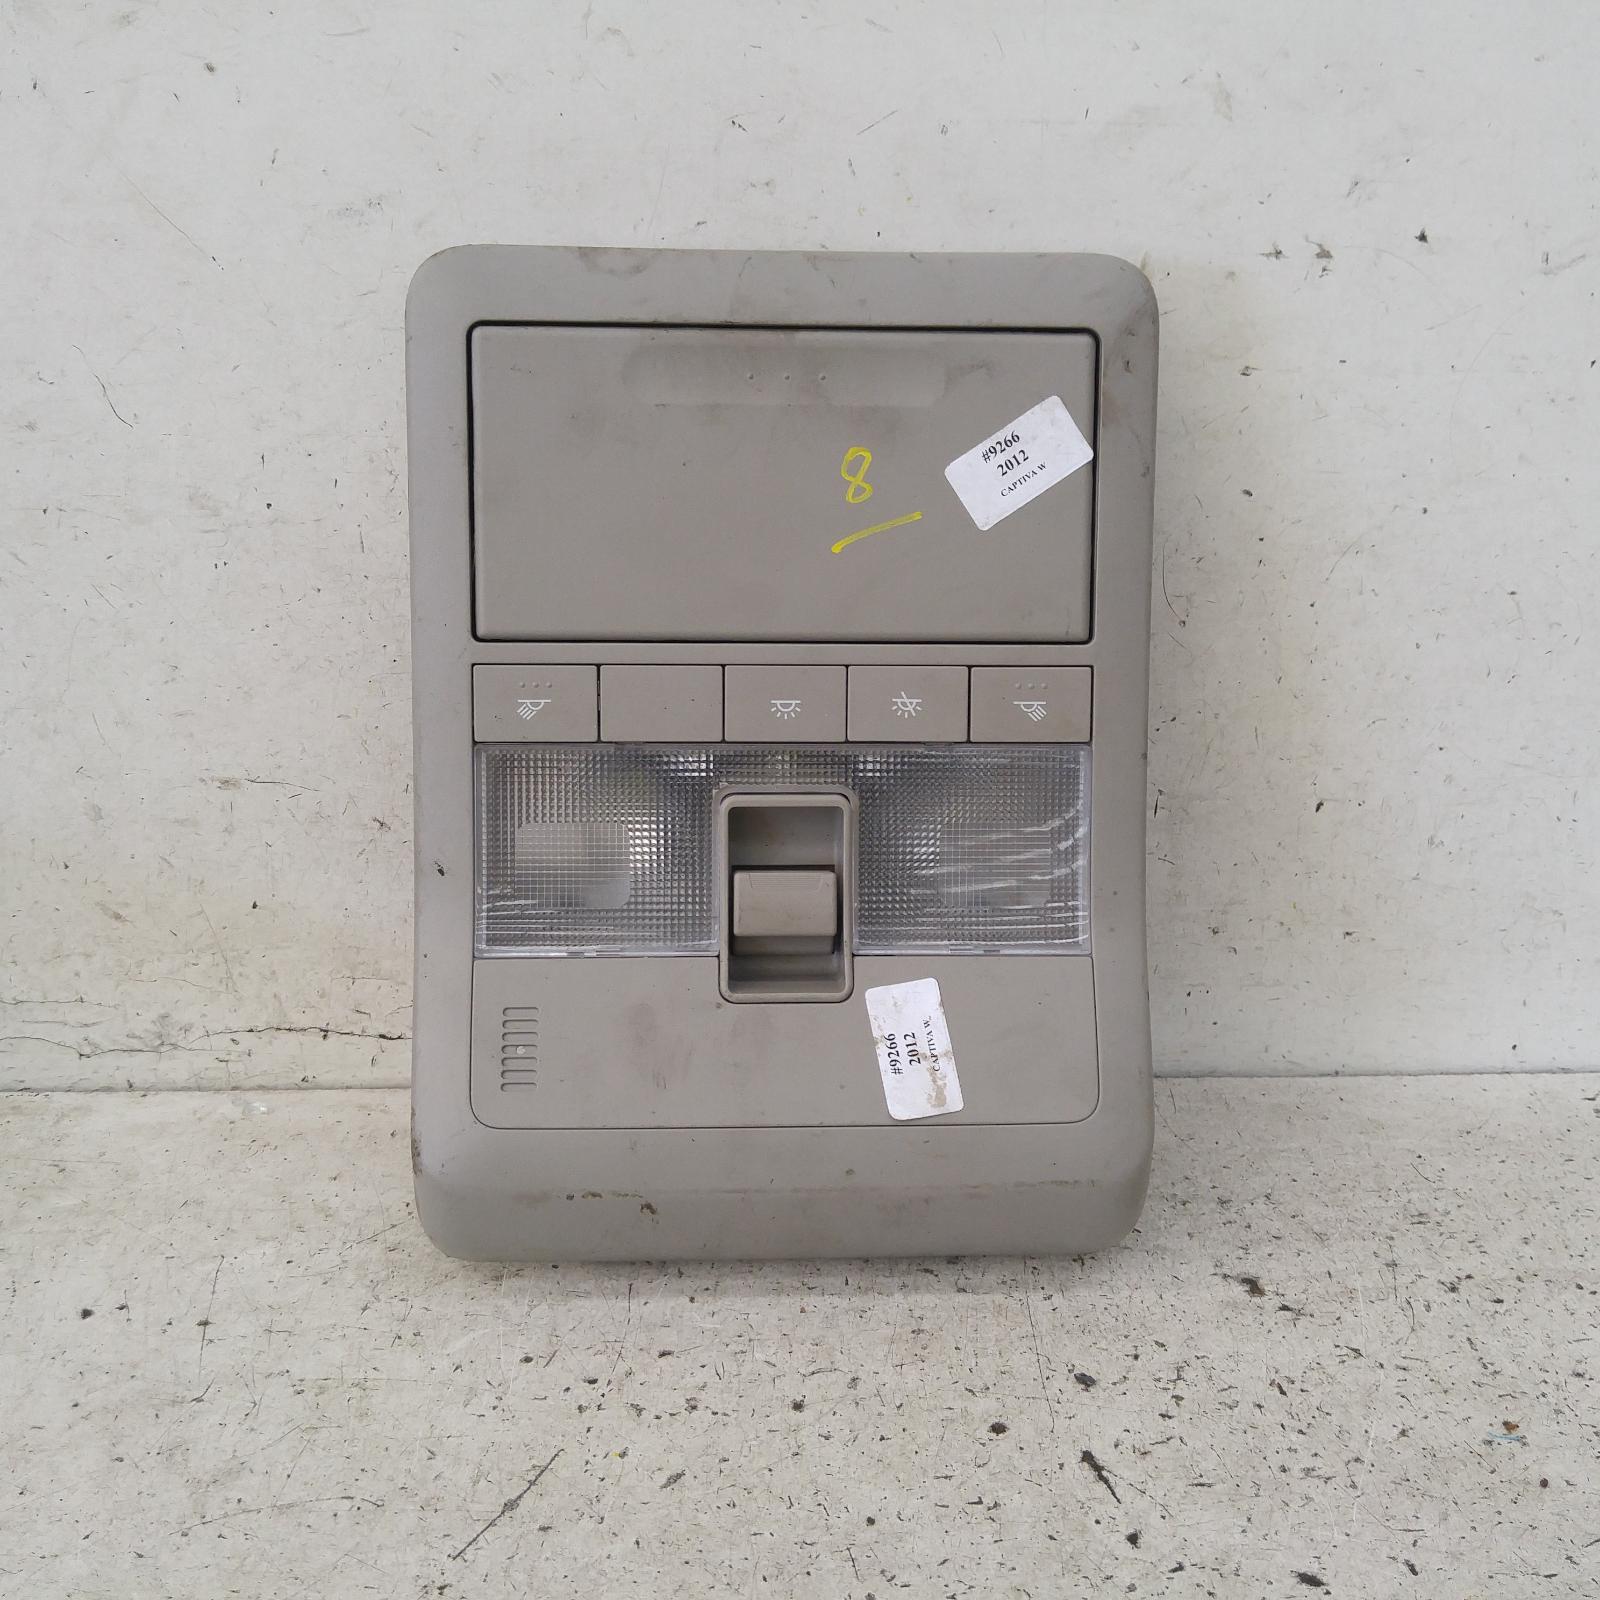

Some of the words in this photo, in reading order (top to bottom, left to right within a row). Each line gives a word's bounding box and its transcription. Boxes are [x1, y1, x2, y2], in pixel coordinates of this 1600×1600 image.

[981, 430, 1021, 464] #9266
[996, 449, 1029, 477] 2012
[840, 446, 873, 504] 8
[1000, 469, 1038, 497] CAPTIVA
[1037, 461, 1047, 471] W
[883, 1033, 904, 1075] #9266
[903, 1032, 921, 1066] 2012
